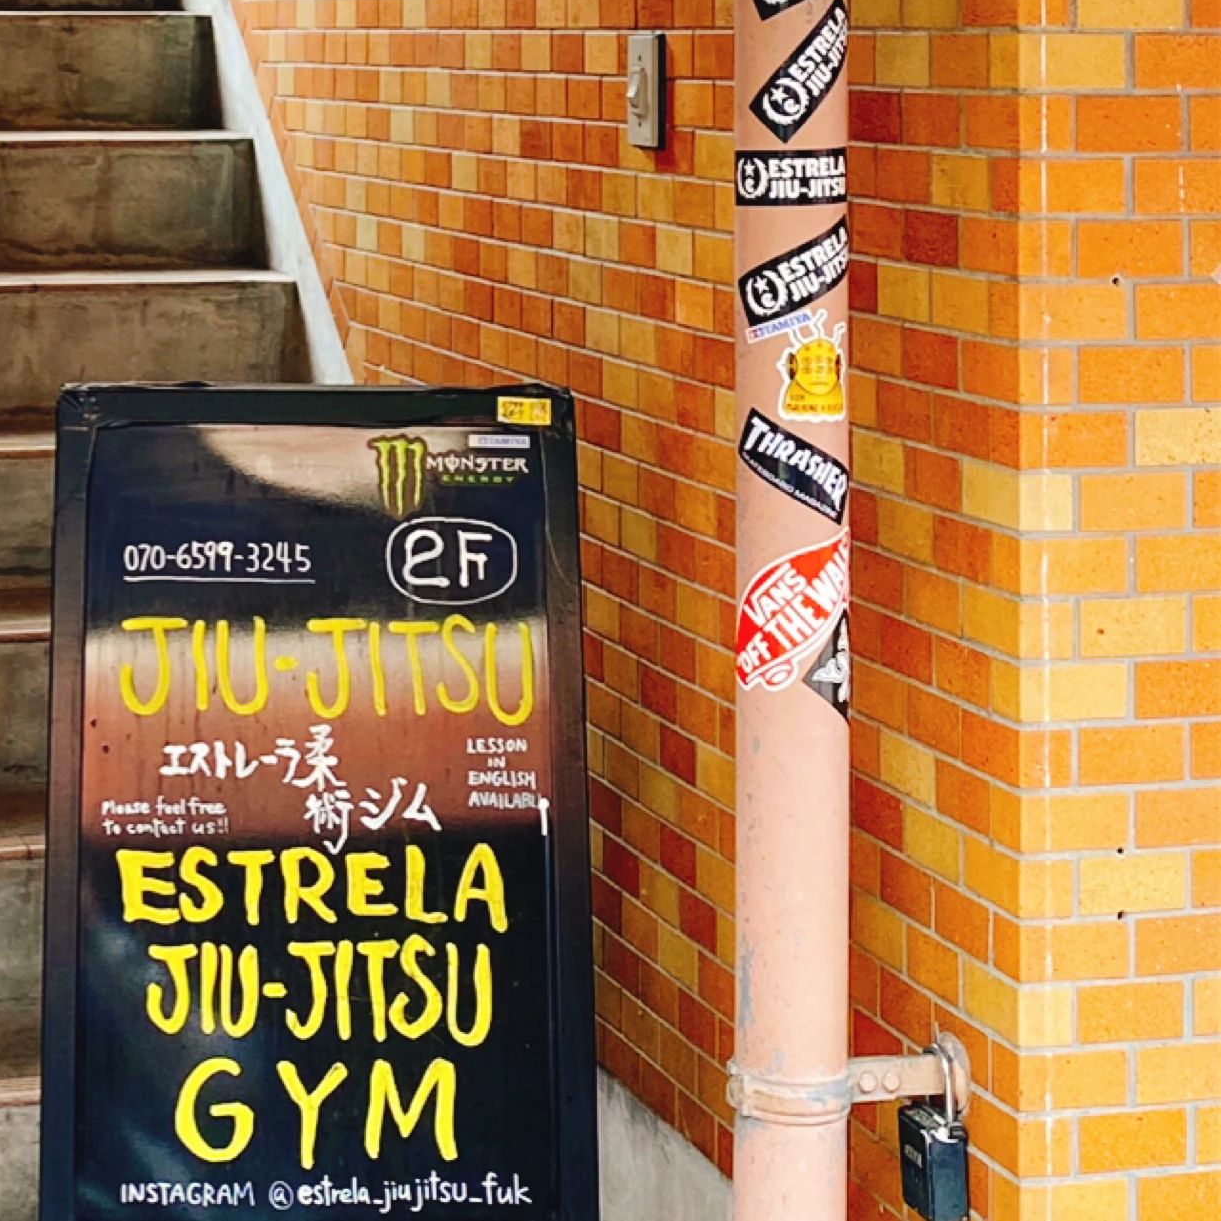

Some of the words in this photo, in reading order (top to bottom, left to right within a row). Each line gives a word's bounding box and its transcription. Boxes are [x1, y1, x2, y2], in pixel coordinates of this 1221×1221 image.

[768, 156, 846, 178] ESTRELA
[427, 455, 529, 474] MONSTER
[744, 416, 847, 512] THRASHER
[123, 541, 312, 573] 070-6599-3245
[743, 562, 807, 627] VANS
[763, 594, 827, 653] THE
[119, 613, 534, 726] JIU-JITSU
[466, 737, 528, 754] LESSON
[487, 755, 506, 769] IN
[468, 770, 537, 790] ENGLISH
[101, 799, 151, 816] Please
[156, 794, 186, 816] feel
[187, 795, 227, 816] free
[125, 817, 186, 839] contact
[116, 843, 508, 932] ESTRELA
[145, 933, 493, 1047] JIU-JITSU
[174, 1057, 458, 1169] GYM
[120, 1180, 256, 1207] INSTAGRAM
